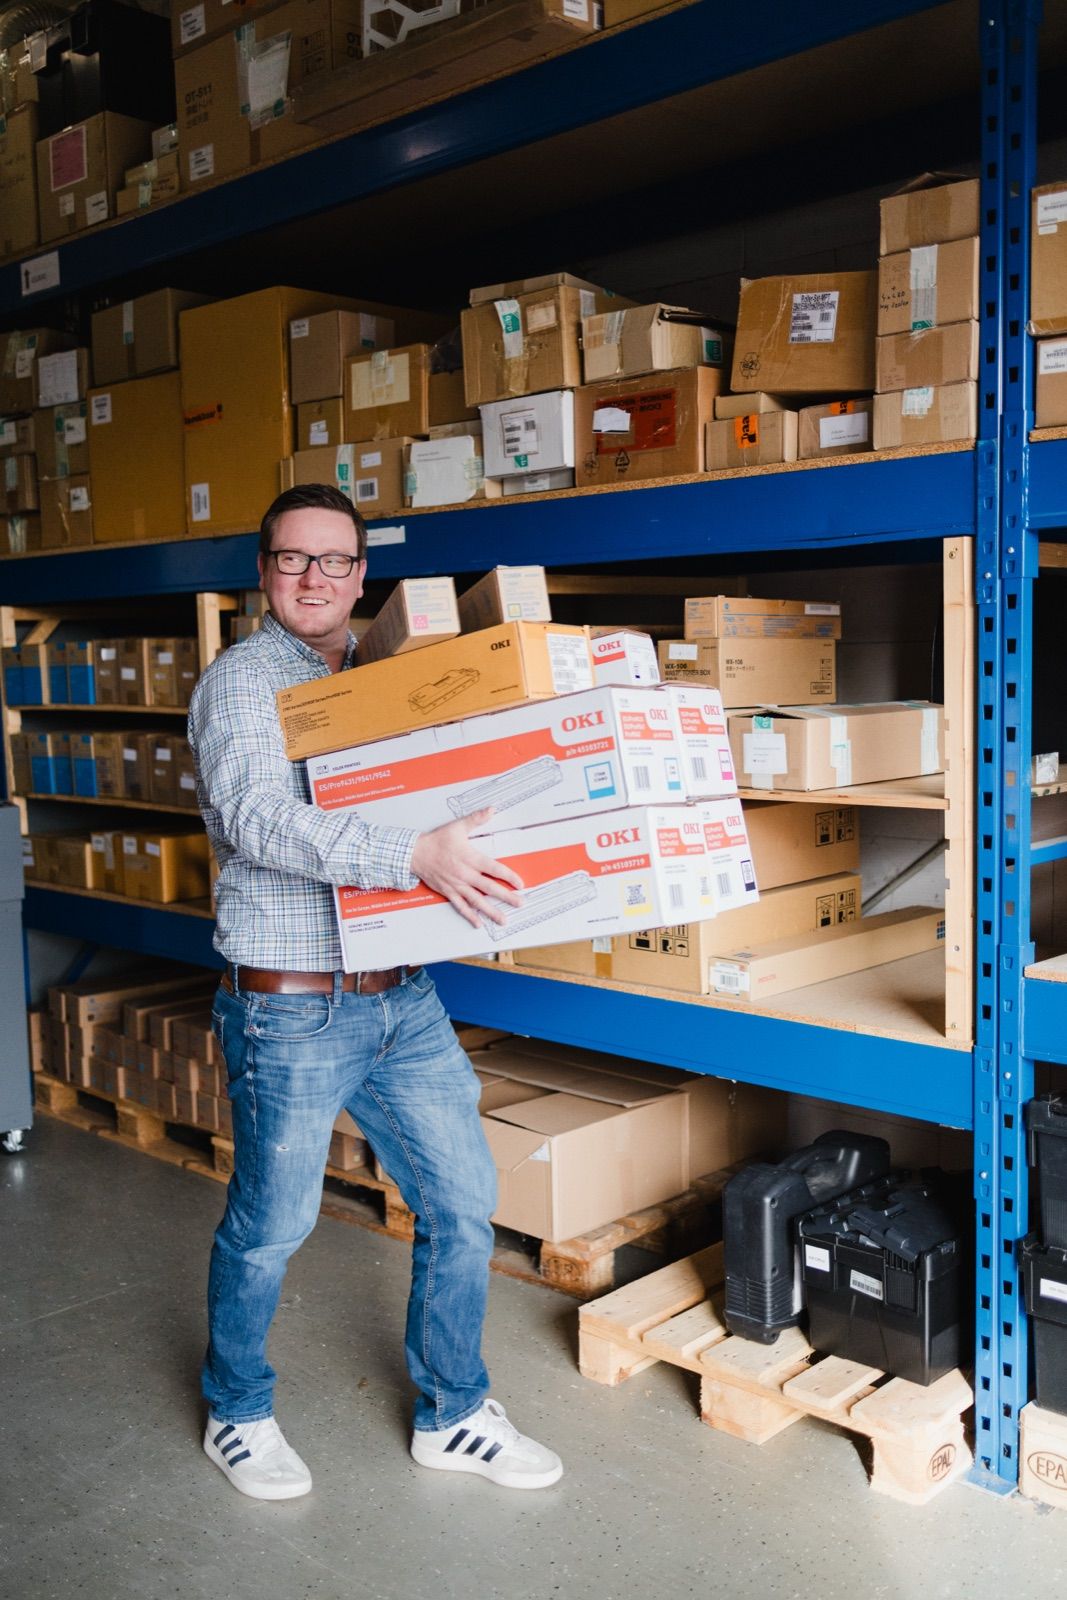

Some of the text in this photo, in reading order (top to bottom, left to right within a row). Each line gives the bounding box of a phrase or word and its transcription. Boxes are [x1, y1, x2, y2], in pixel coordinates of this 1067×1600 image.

[490, 639, 511, 651] OKI
[598, 640, 622, 652] OKI
[649, 708, 668, 720] OKI
[704, 704, 721, 716] OKI
[561, 710, 605, 732] OKI
[727, 815, 741, 827] OKI
[683, 823, 700, 834] OKI
[596, 827, 641, 848] OKI
[932, 1450, 952, 1477] EPAL
